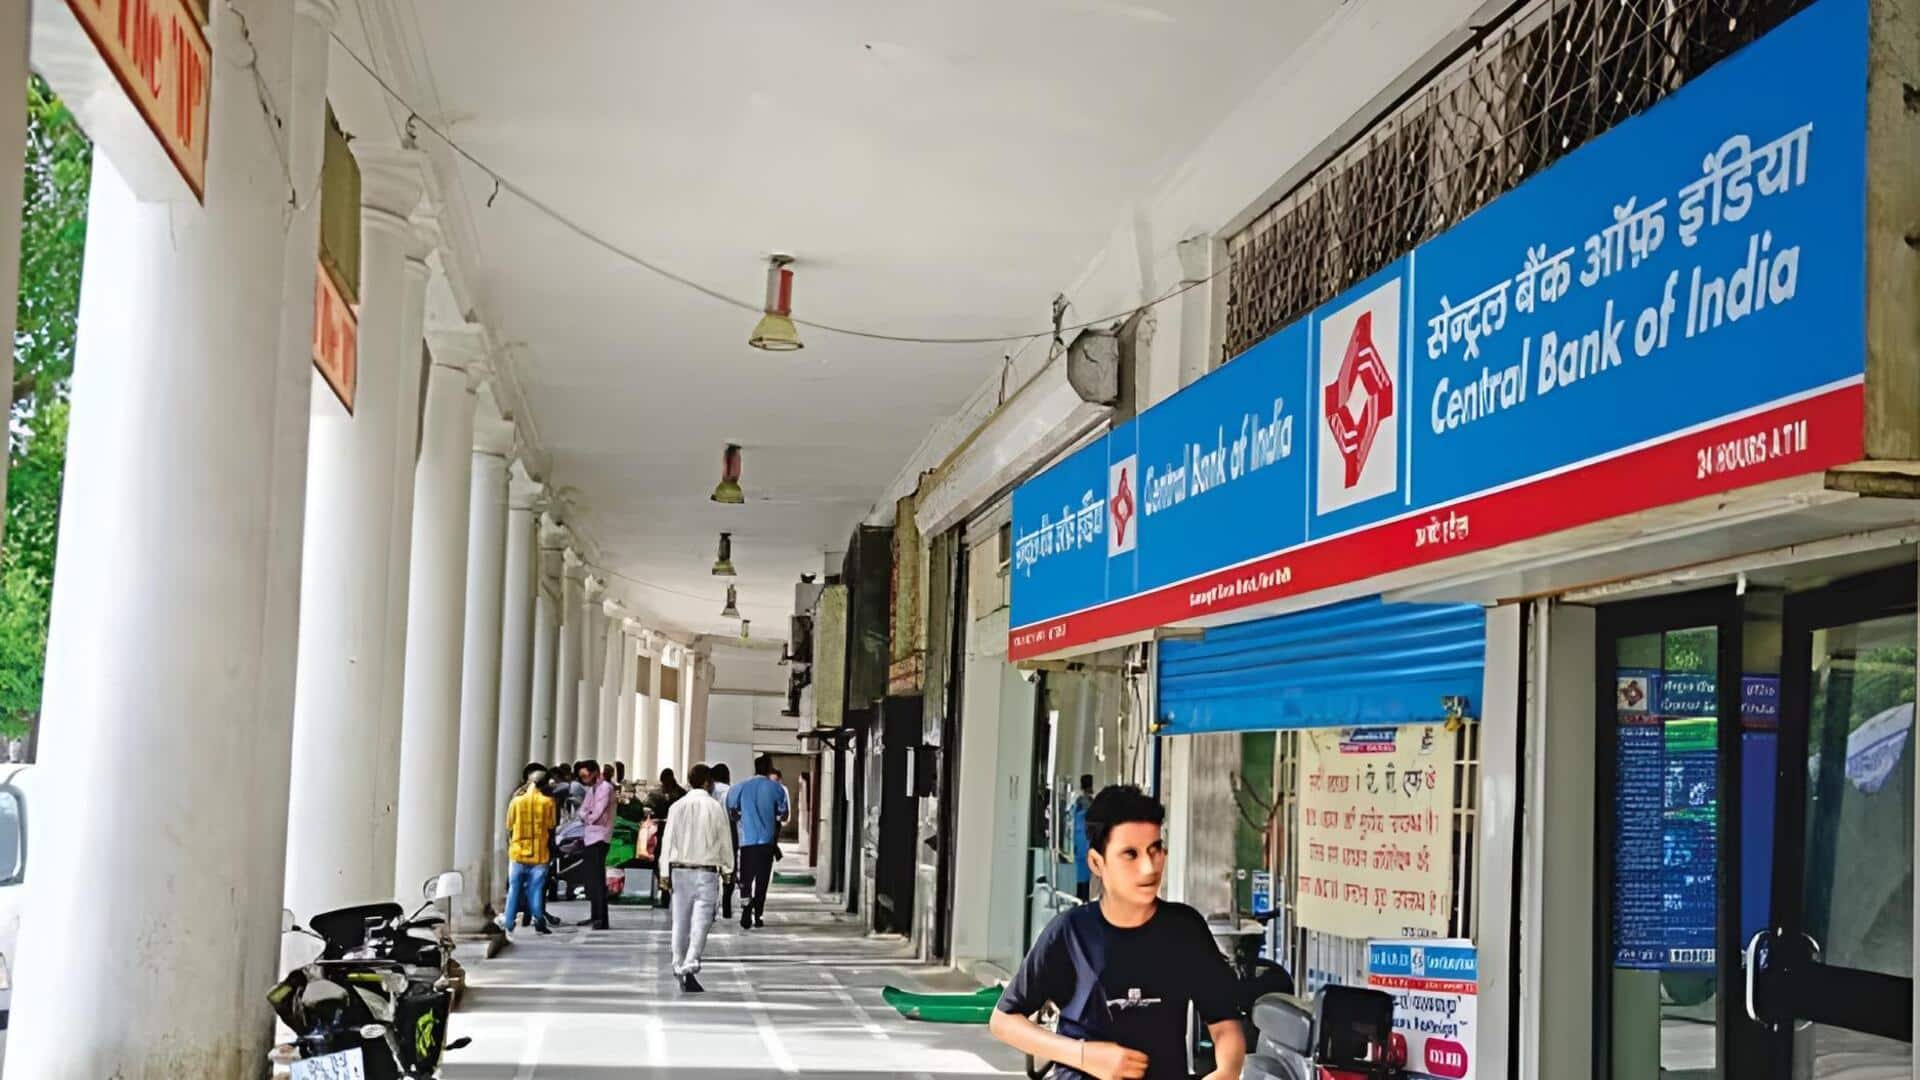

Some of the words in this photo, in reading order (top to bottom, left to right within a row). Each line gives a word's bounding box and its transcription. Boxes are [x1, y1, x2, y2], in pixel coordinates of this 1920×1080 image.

[1427, 279, 1512, 361] सेन्ट्रल
[1515, 243, 1575, 313] बैंक
[1679, 122, 1813, 247] इंडिया
[1431, 337, 1530, 434] Central
[1537, 299, 1625, 395] Bank
[1634, 270, 1679, 357] of
[1686, 230, 1800, 338] India
[1144, 443, 1190, 516] Central
[1190, 424, 1226, 497] Bank
[1230, 413, 1248, 480] of
[1250, 397, 1293, 472] India
[1715, 431, 1767, 473] HOURS
